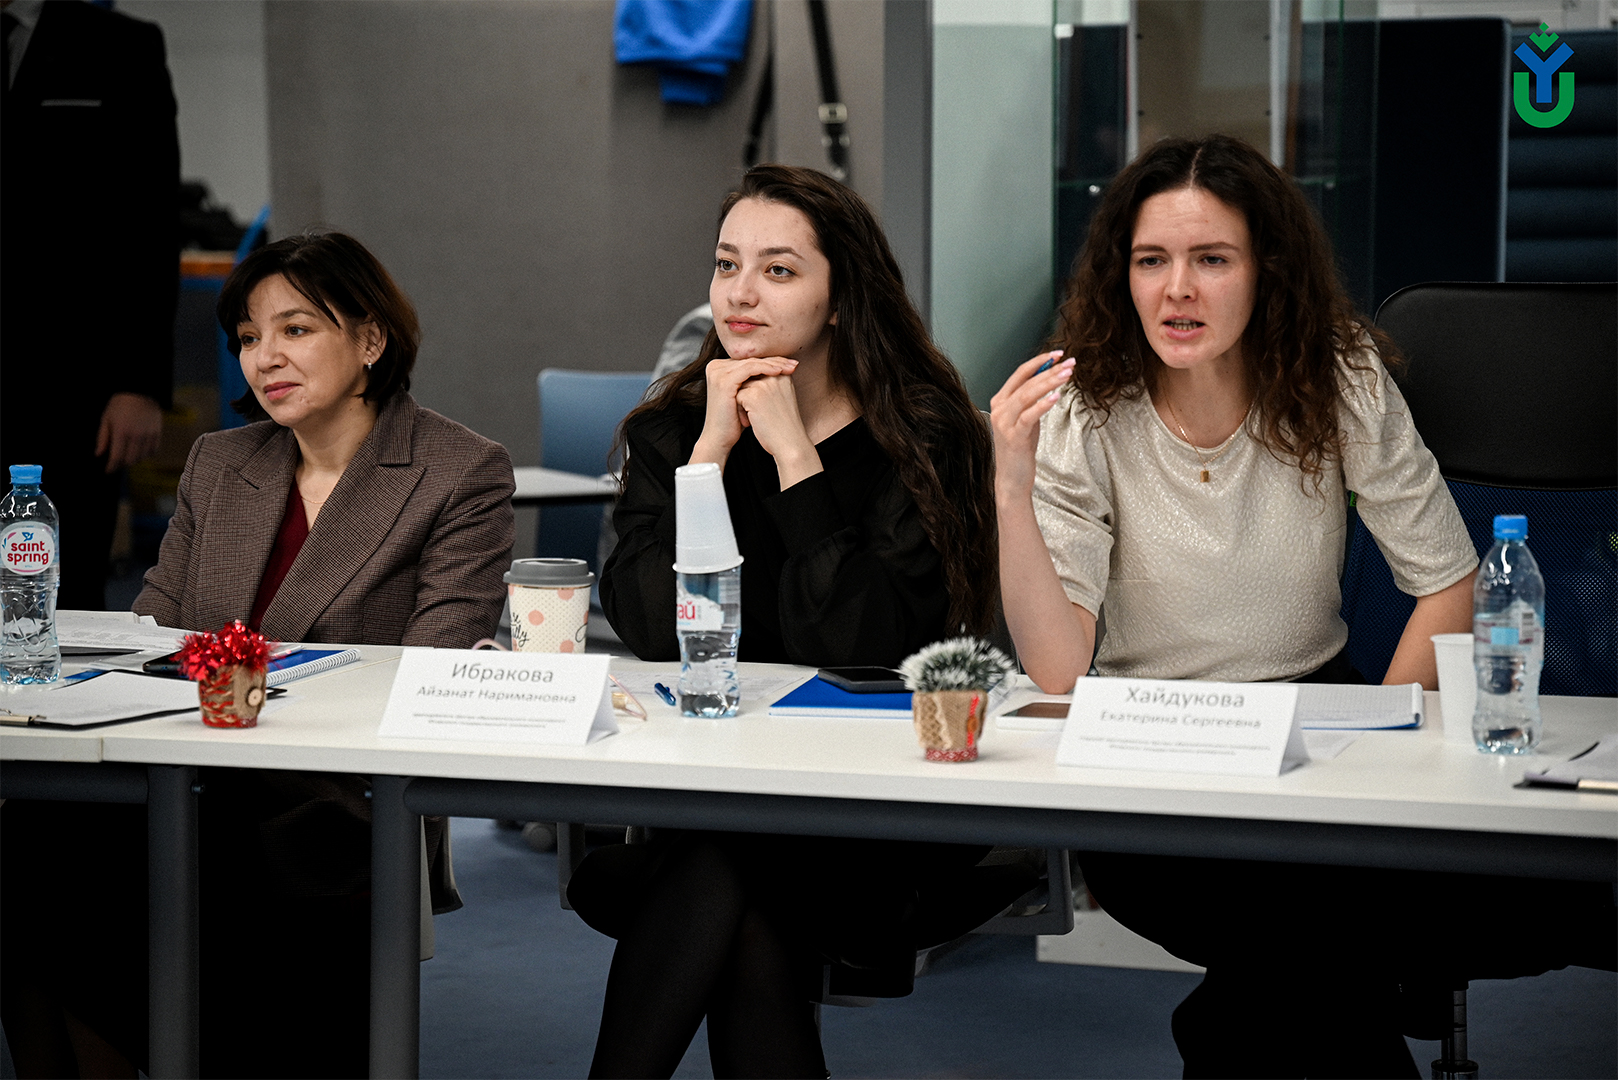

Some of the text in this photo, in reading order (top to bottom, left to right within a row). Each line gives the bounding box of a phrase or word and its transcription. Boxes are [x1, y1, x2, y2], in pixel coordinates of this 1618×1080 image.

[11, 541, 46, 552] saint
[7, 552, 49, 565] spring
[451, 662, 554, 683] Ибракова
[416, 685, 577, 704] Айзанат Наримановна
[1125, 687, 1245, 709] Хайдукова
[1100, 710, 1262, 729] Екатерина Сергеевна
